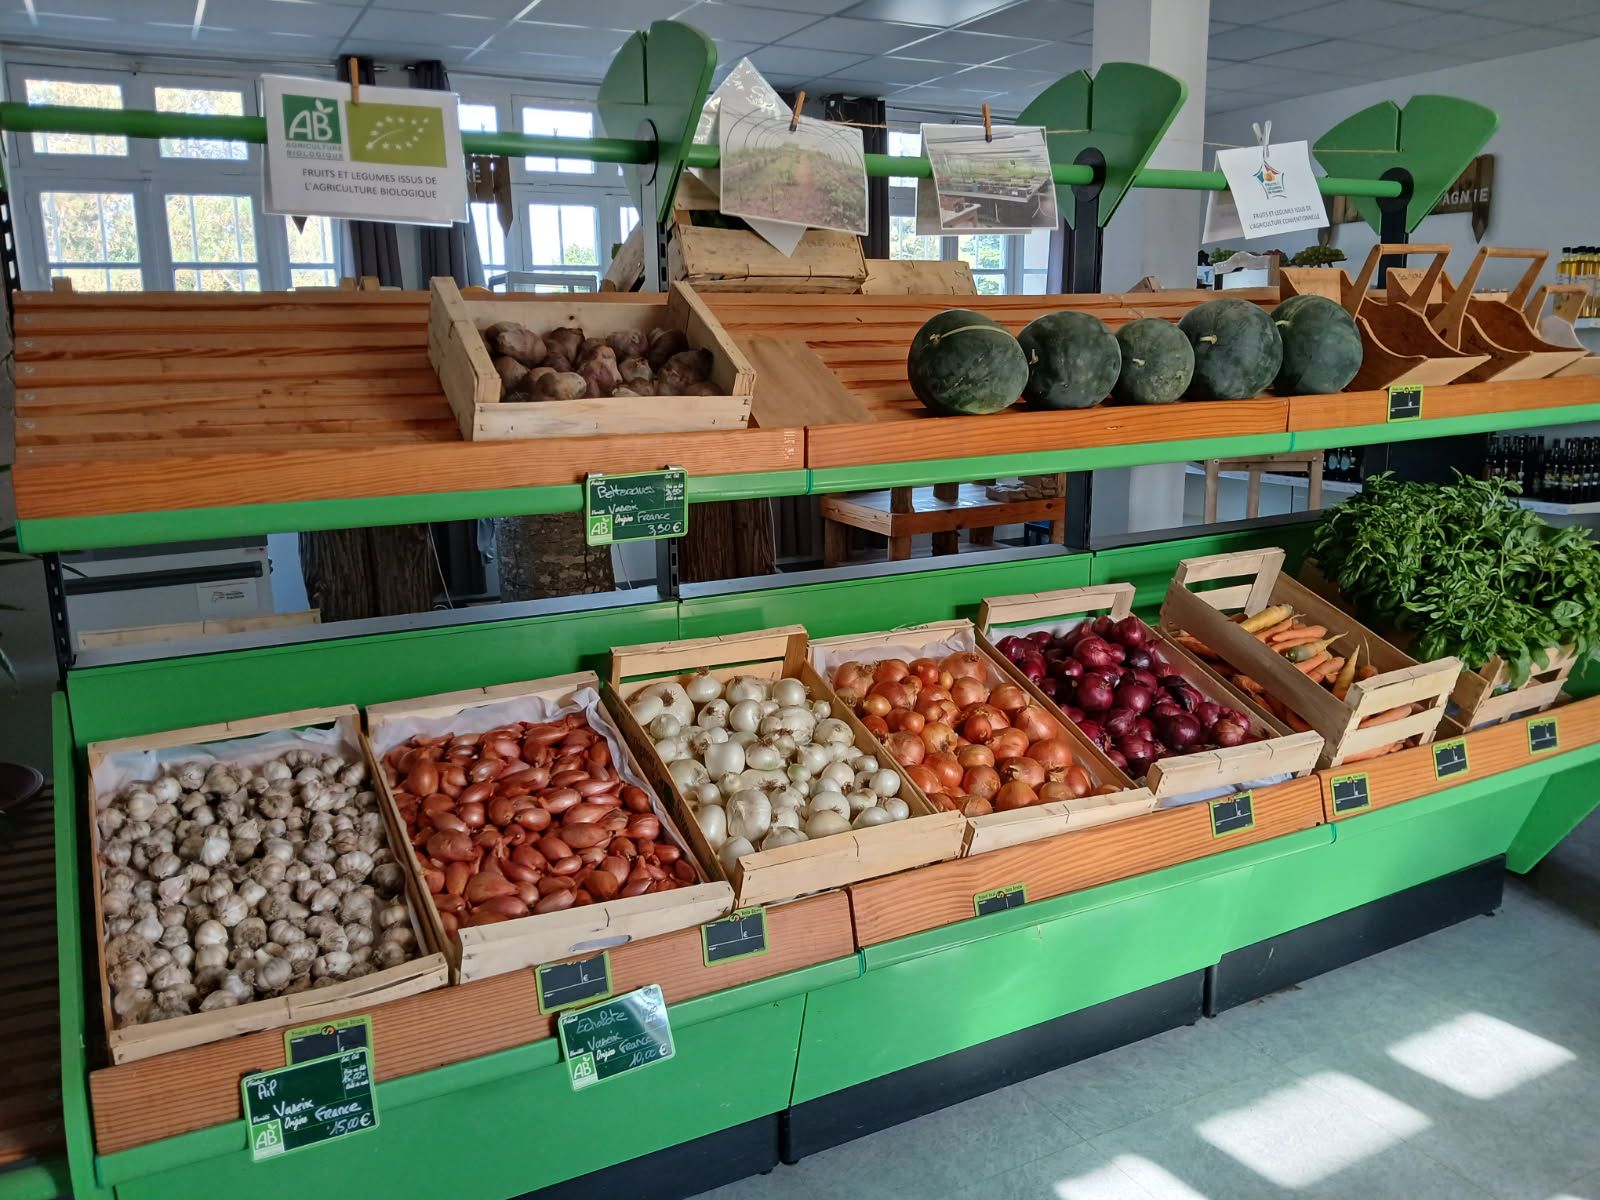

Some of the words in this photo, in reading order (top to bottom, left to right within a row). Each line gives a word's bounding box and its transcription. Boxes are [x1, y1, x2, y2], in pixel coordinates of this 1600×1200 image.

[289, 110, 332, 140] AB
[302, 168, 336, 179] FRUITS
[338, 171, 348, 180] ET
[351, 172, 396, 182] LEGUMES
[398, 175, 423, 185] ISSUS
[426, 176, 437, 185] DE
[304, 182, 377, 195] L'AGRICULTURE
[380, 186, 437, 198] BIOLOGIQUE
[1442, 188, 1488, 206] AGNIE
[1275, 208, 1294, 216] LEGUMES
[1249, 218, 1282, 230] L'AGRICULTURE
[1282, 214, 1320, 224] CONVENTIONNELLE
[637, 511, 670, 522] France
[592, 522, 608, 535] AB
[619, 1036, 652, 1053] France
[574, 1062, 592, 1080] AB
[314, 1102, 362, 1121] France
[256, 1130, 278, 1150] AB
